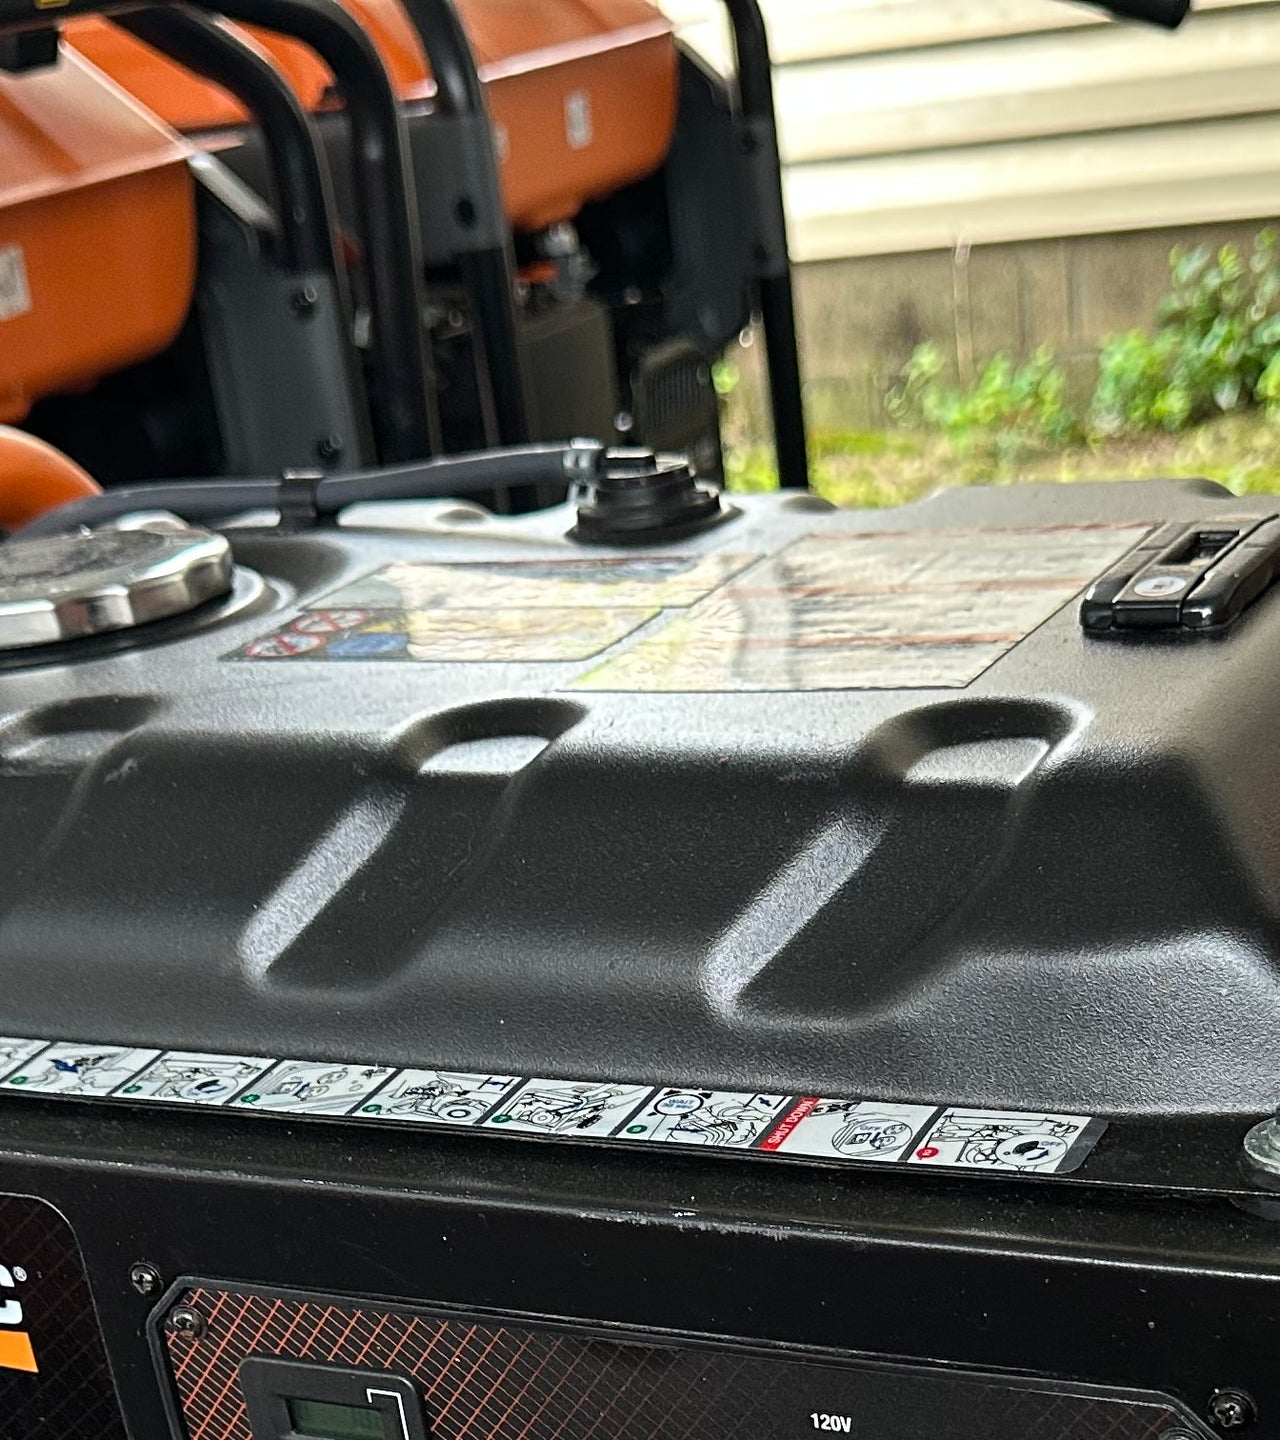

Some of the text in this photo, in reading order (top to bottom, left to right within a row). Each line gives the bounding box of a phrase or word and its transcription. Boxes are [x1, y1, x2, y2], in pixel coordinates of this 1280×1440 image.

[767, 1100, 814, 1144] SHUT DOWN
[810, 1412, 852, 1433] 120V
